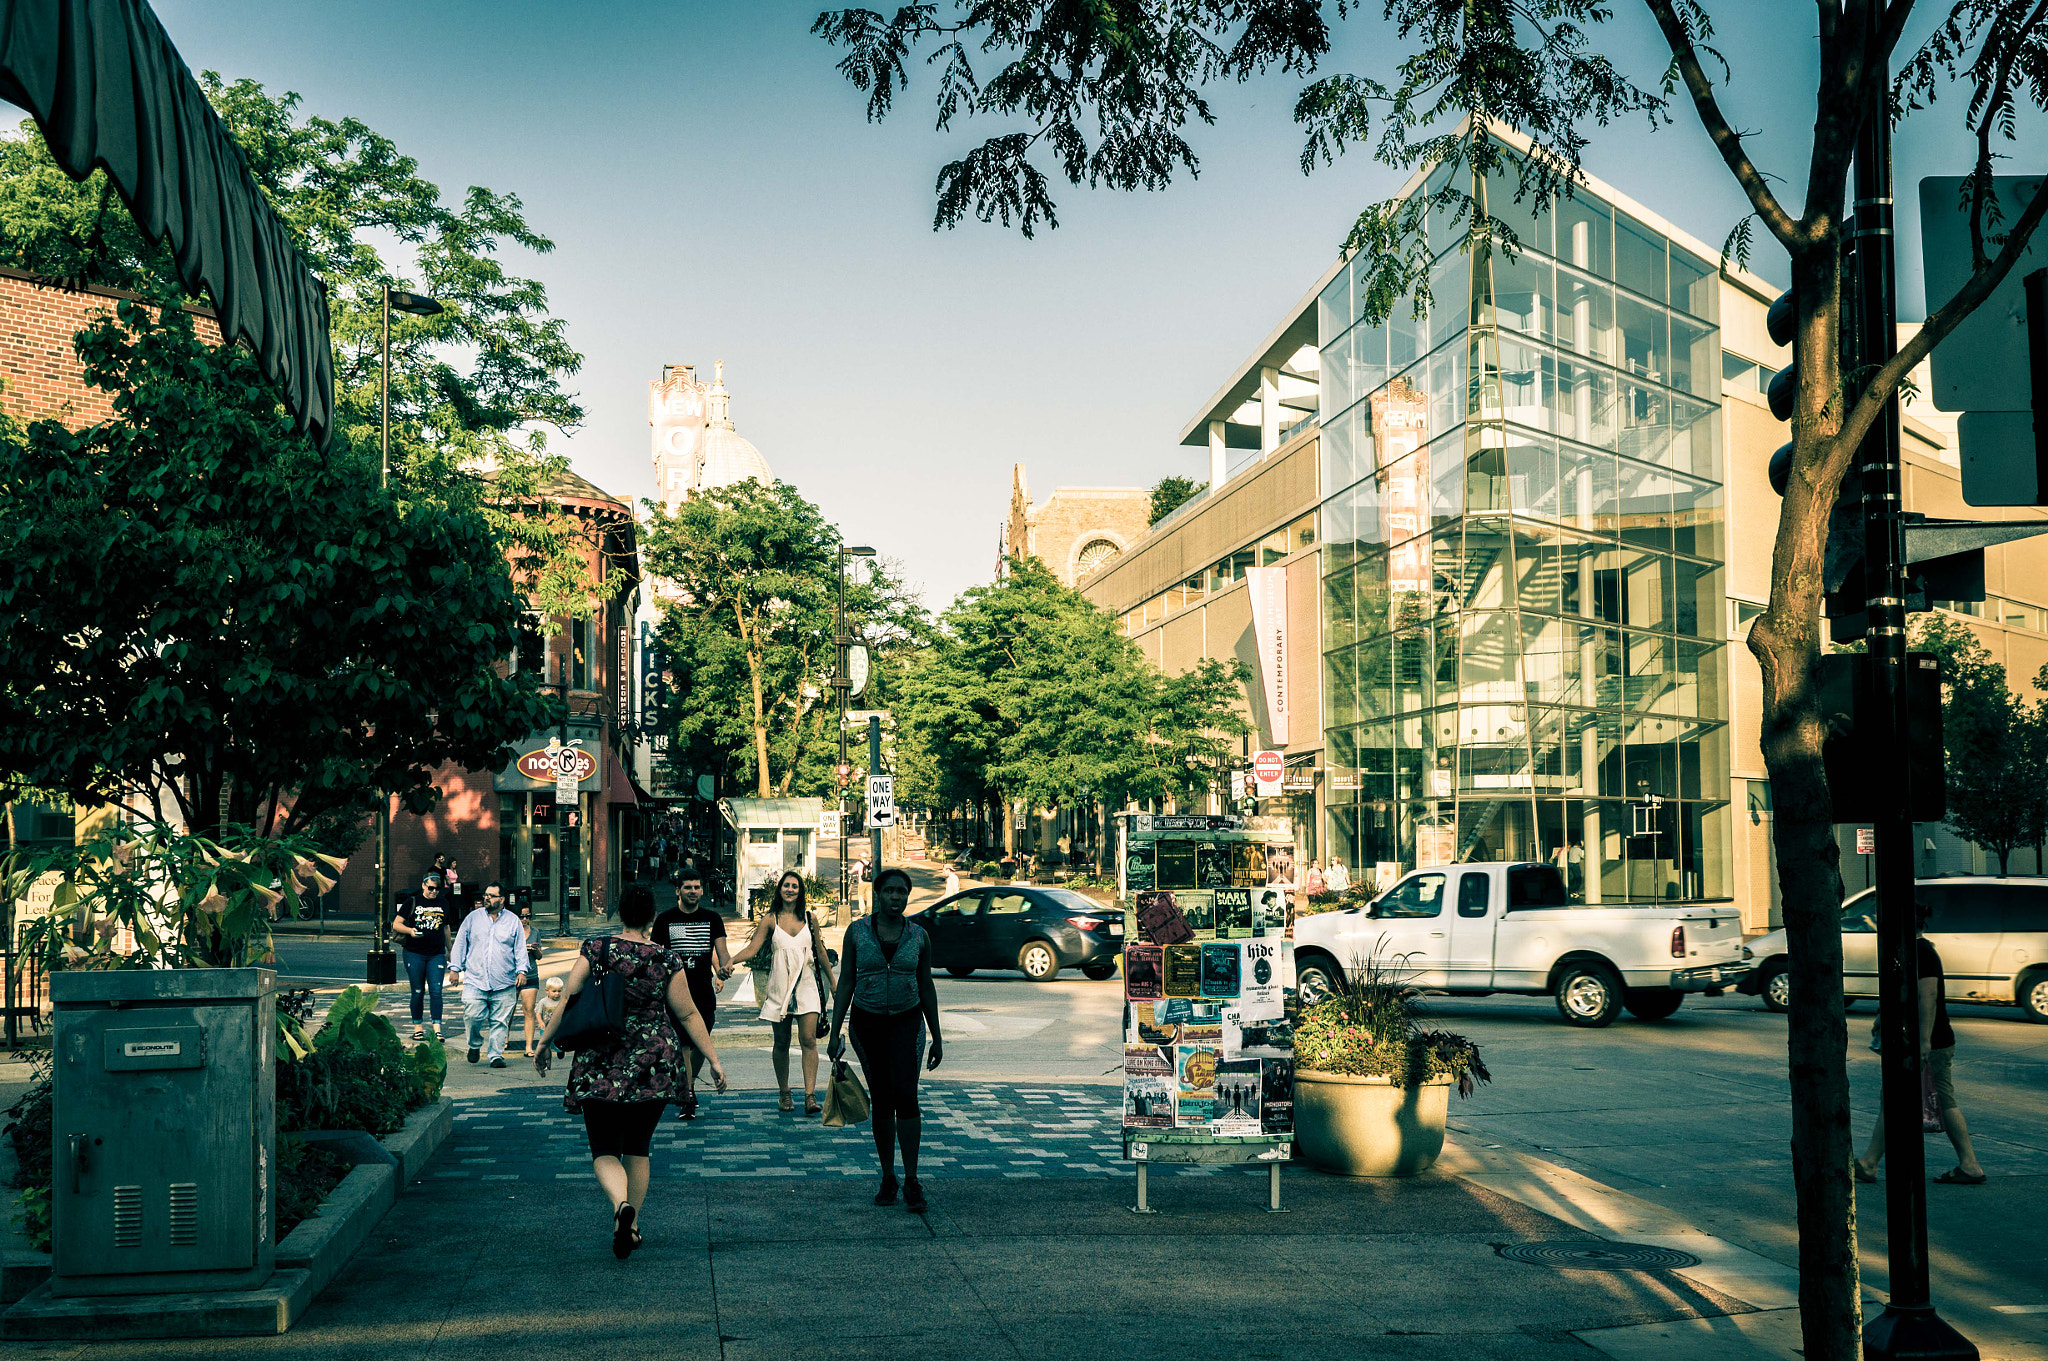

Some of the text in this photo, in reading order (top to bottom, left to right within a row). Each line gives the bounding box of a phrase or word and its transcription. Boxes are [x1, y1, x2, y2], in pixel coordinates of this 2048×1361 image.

[655, 400, 702, 417] NEW
[1276, 629, 1284, 713] CONTEMPORARY
[528, 757, 590, 770] nooes
[873, 781, 890, 793] ONE
[872, 796, 891, 808] WAY
[32, 877, 57, 888] pace
[32, 892, 51, 902] For
[1217, 891, 1247, 900] MARK
[25, 905, 51, 914] Leas
[1247, 943, 1274, 960] hide
